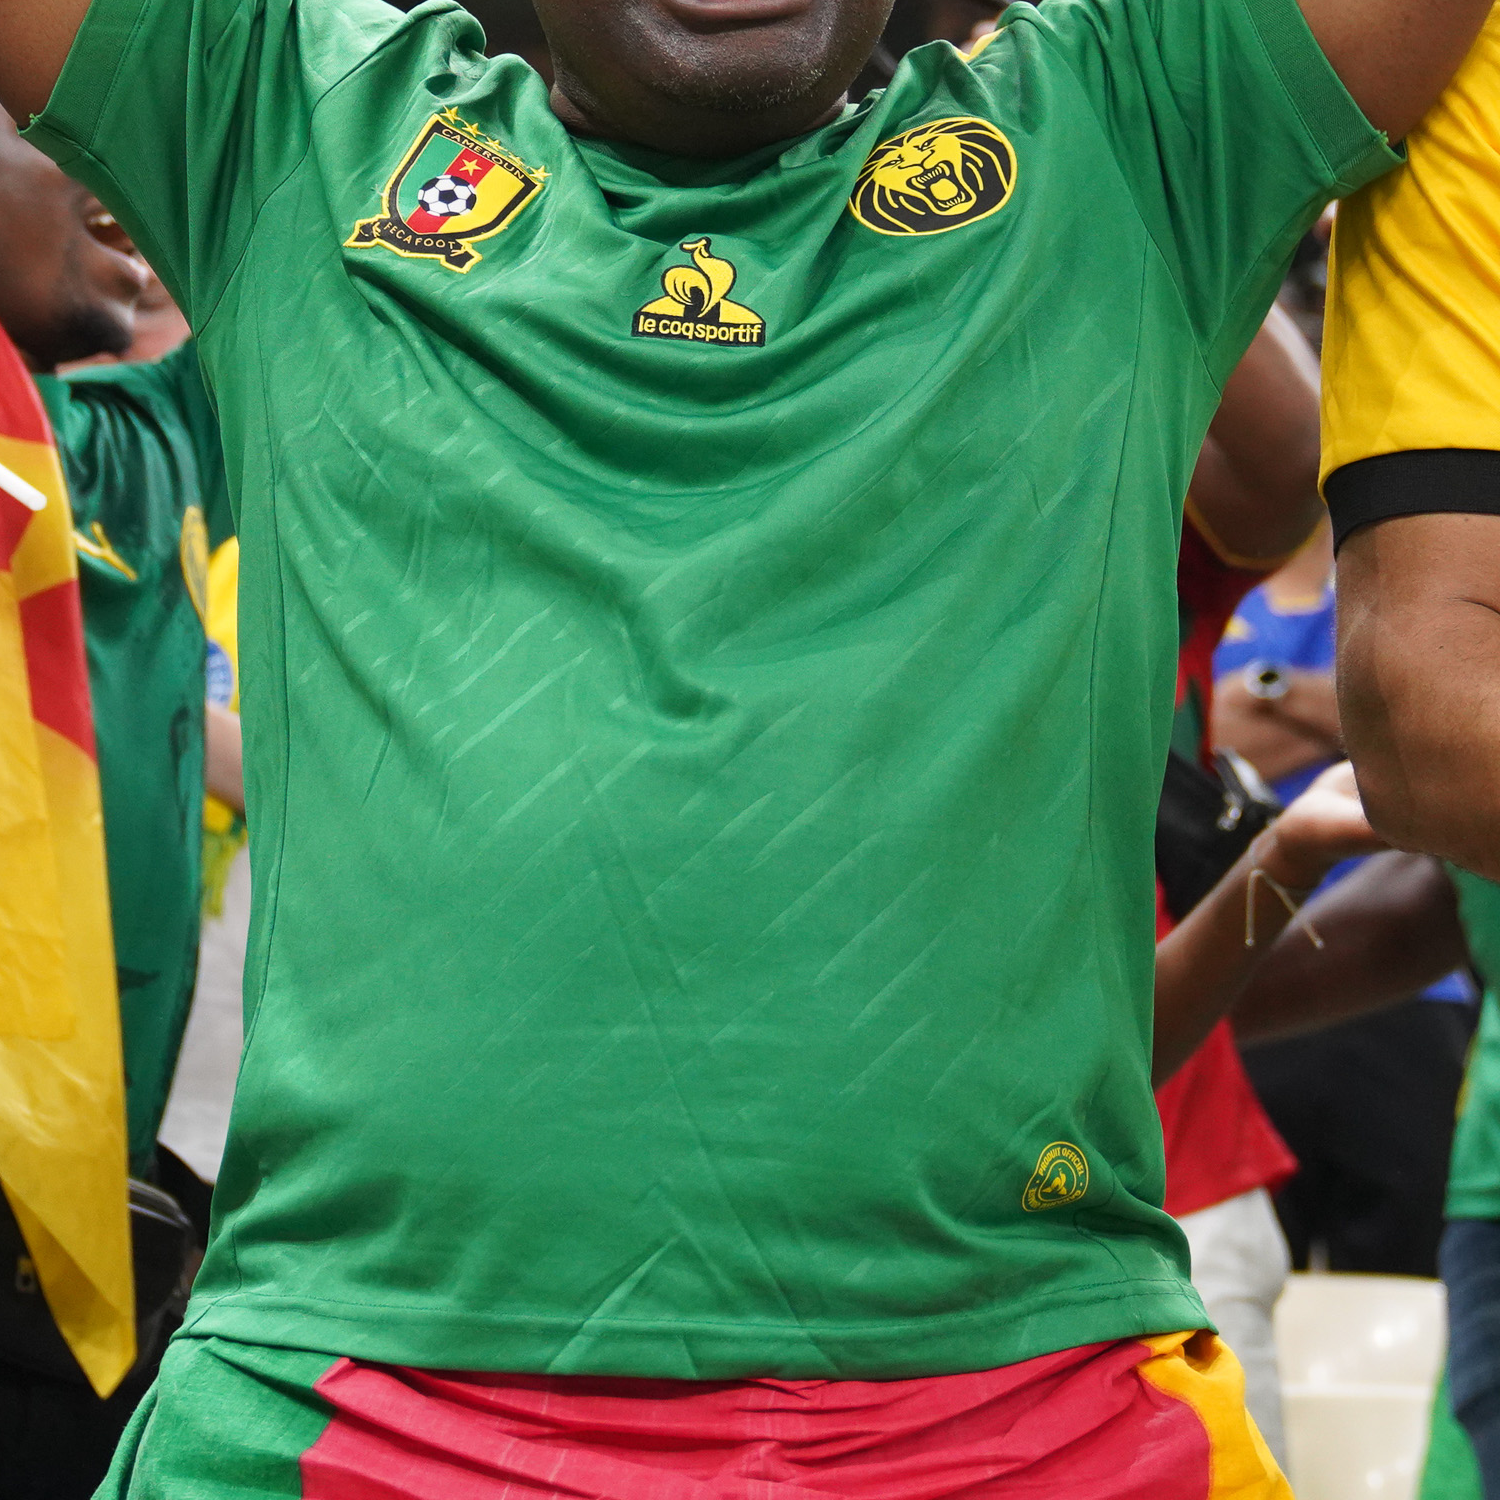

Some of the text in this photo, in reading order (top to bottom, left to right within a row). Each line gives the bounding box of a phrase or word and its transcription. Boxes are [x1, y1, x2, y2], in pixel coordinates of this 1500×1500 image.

[440, 127, 526, 180] CAMEROUN
[383, 221, 456, 250] FECAFOOT
[638, 315, 656, 333] le
[1039, 1147, 1084, 1176] PRODUIT OFFICIEL
